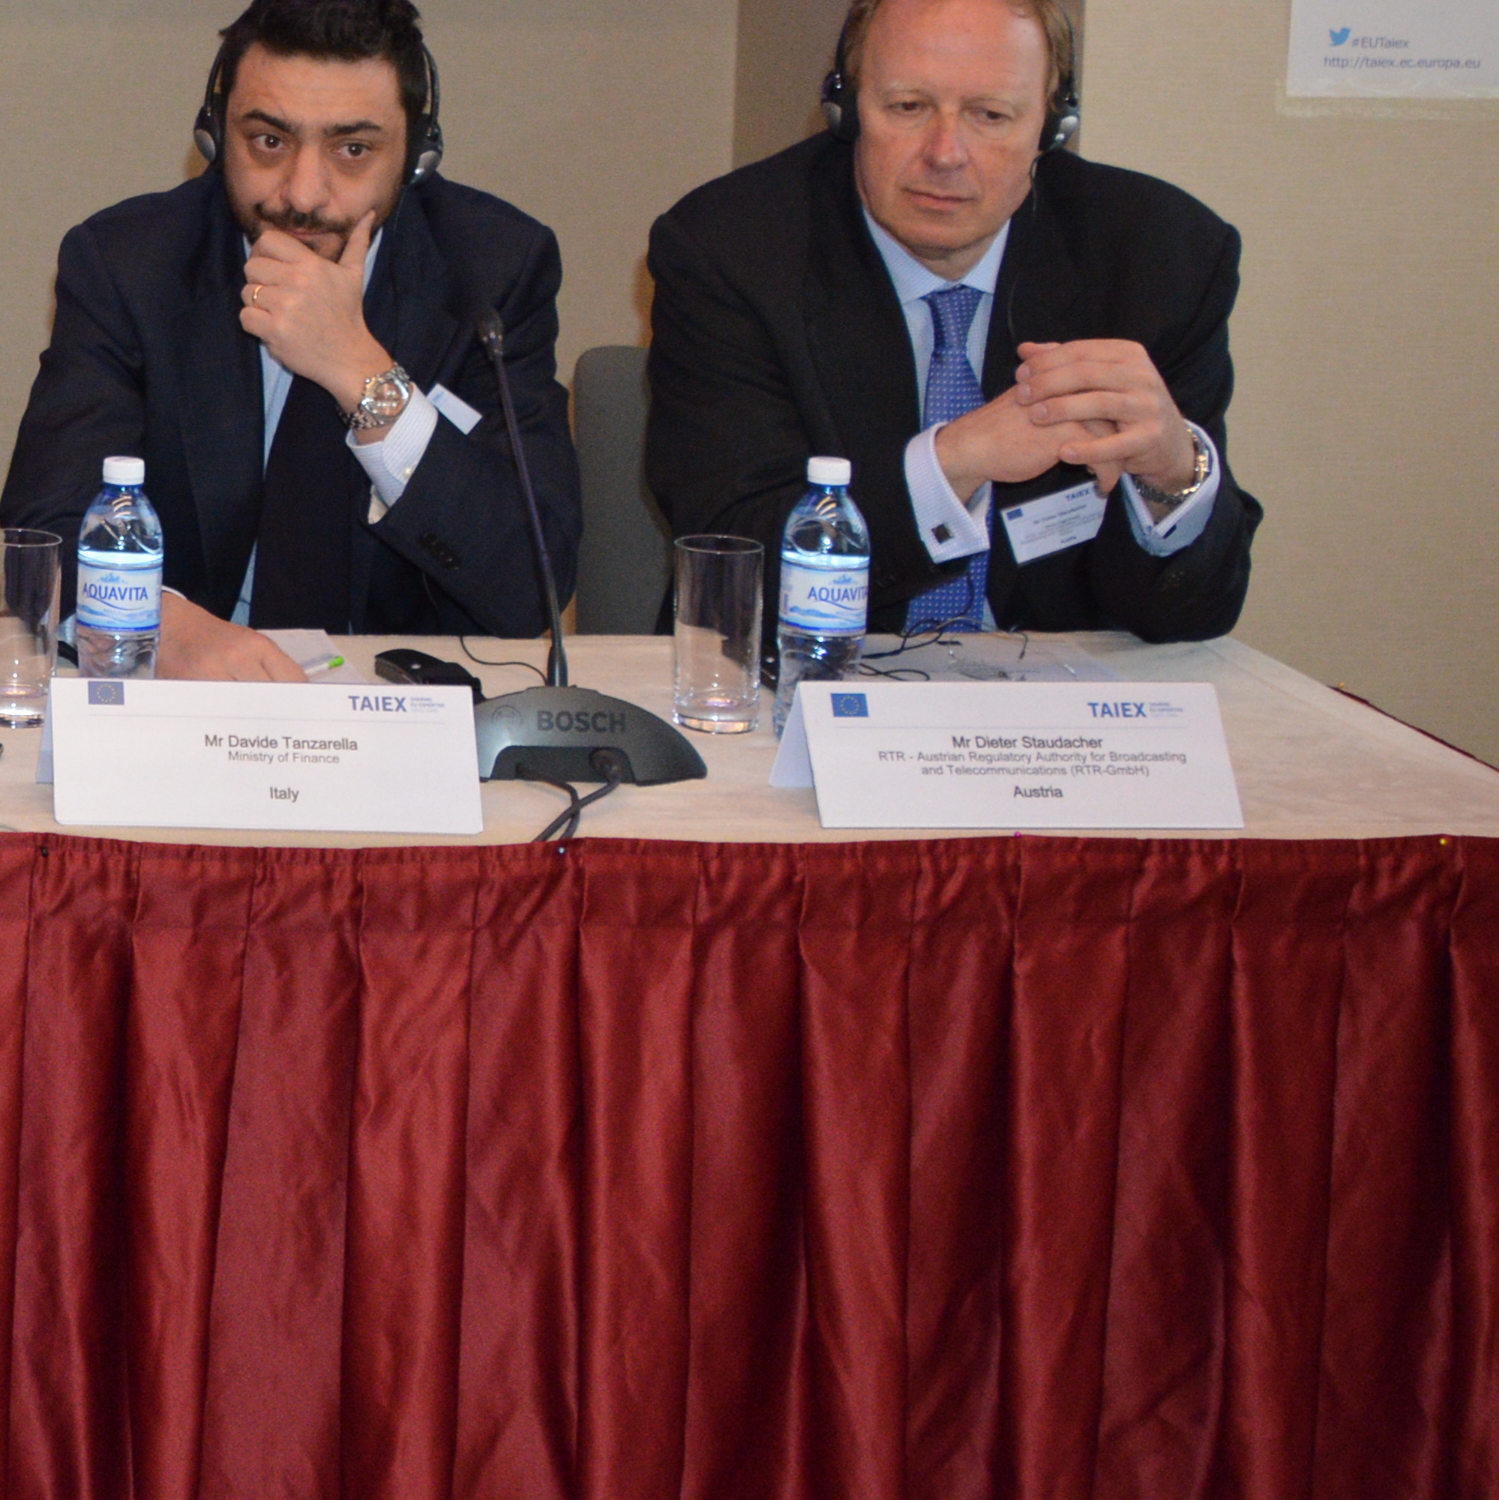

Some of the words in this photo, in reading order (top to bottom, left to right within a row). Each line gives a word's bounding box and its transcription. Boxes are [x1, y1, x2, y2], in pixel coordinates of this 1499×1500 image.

[1351, 37, 1409, 49] #EUTaiex
[1324, 56, 1480, 70] http://taiex.ec.europa.eu
[82, 582, 148, 601] AQUAVITA
[348, 695, 407, 713] TAIEX
[1087, 702, 1147, 718] TAIEX
[536, 710, 626, 733] BOSCH
[204, 734, 223, 747] Mr
[228, 735, 278, 749] Davide
[282, 736, 358, 751] Tanzarella
[952, 735, 970, 748] Mr
[975, 735, 1017, 749] Dieter
[1021, 735, 1103, 750] Staudacher
[228, 750, 274, 765] Ministry
[277, 751, 289, 763] of
[292, 752, 340, 764] Finance
[878, 751, 905, 762] RTR
[917, 751, 965, 762] Austrian
[968, 751, 1032, 765] Regulatory
[1035, 751, 1087, 765] Authority
[1090, 751, 1105, 762] for
[1109, 751, 1187, 766] Broadcasting
[921, 765, 943, 776] and
[947, 765, 1067, 776] Telecommunications
[1070, 765, 1150, 778] (RTR-GmbH)
[269, 786, 300, 803] Italy
[1013, 785, 1063, 799] Austria
